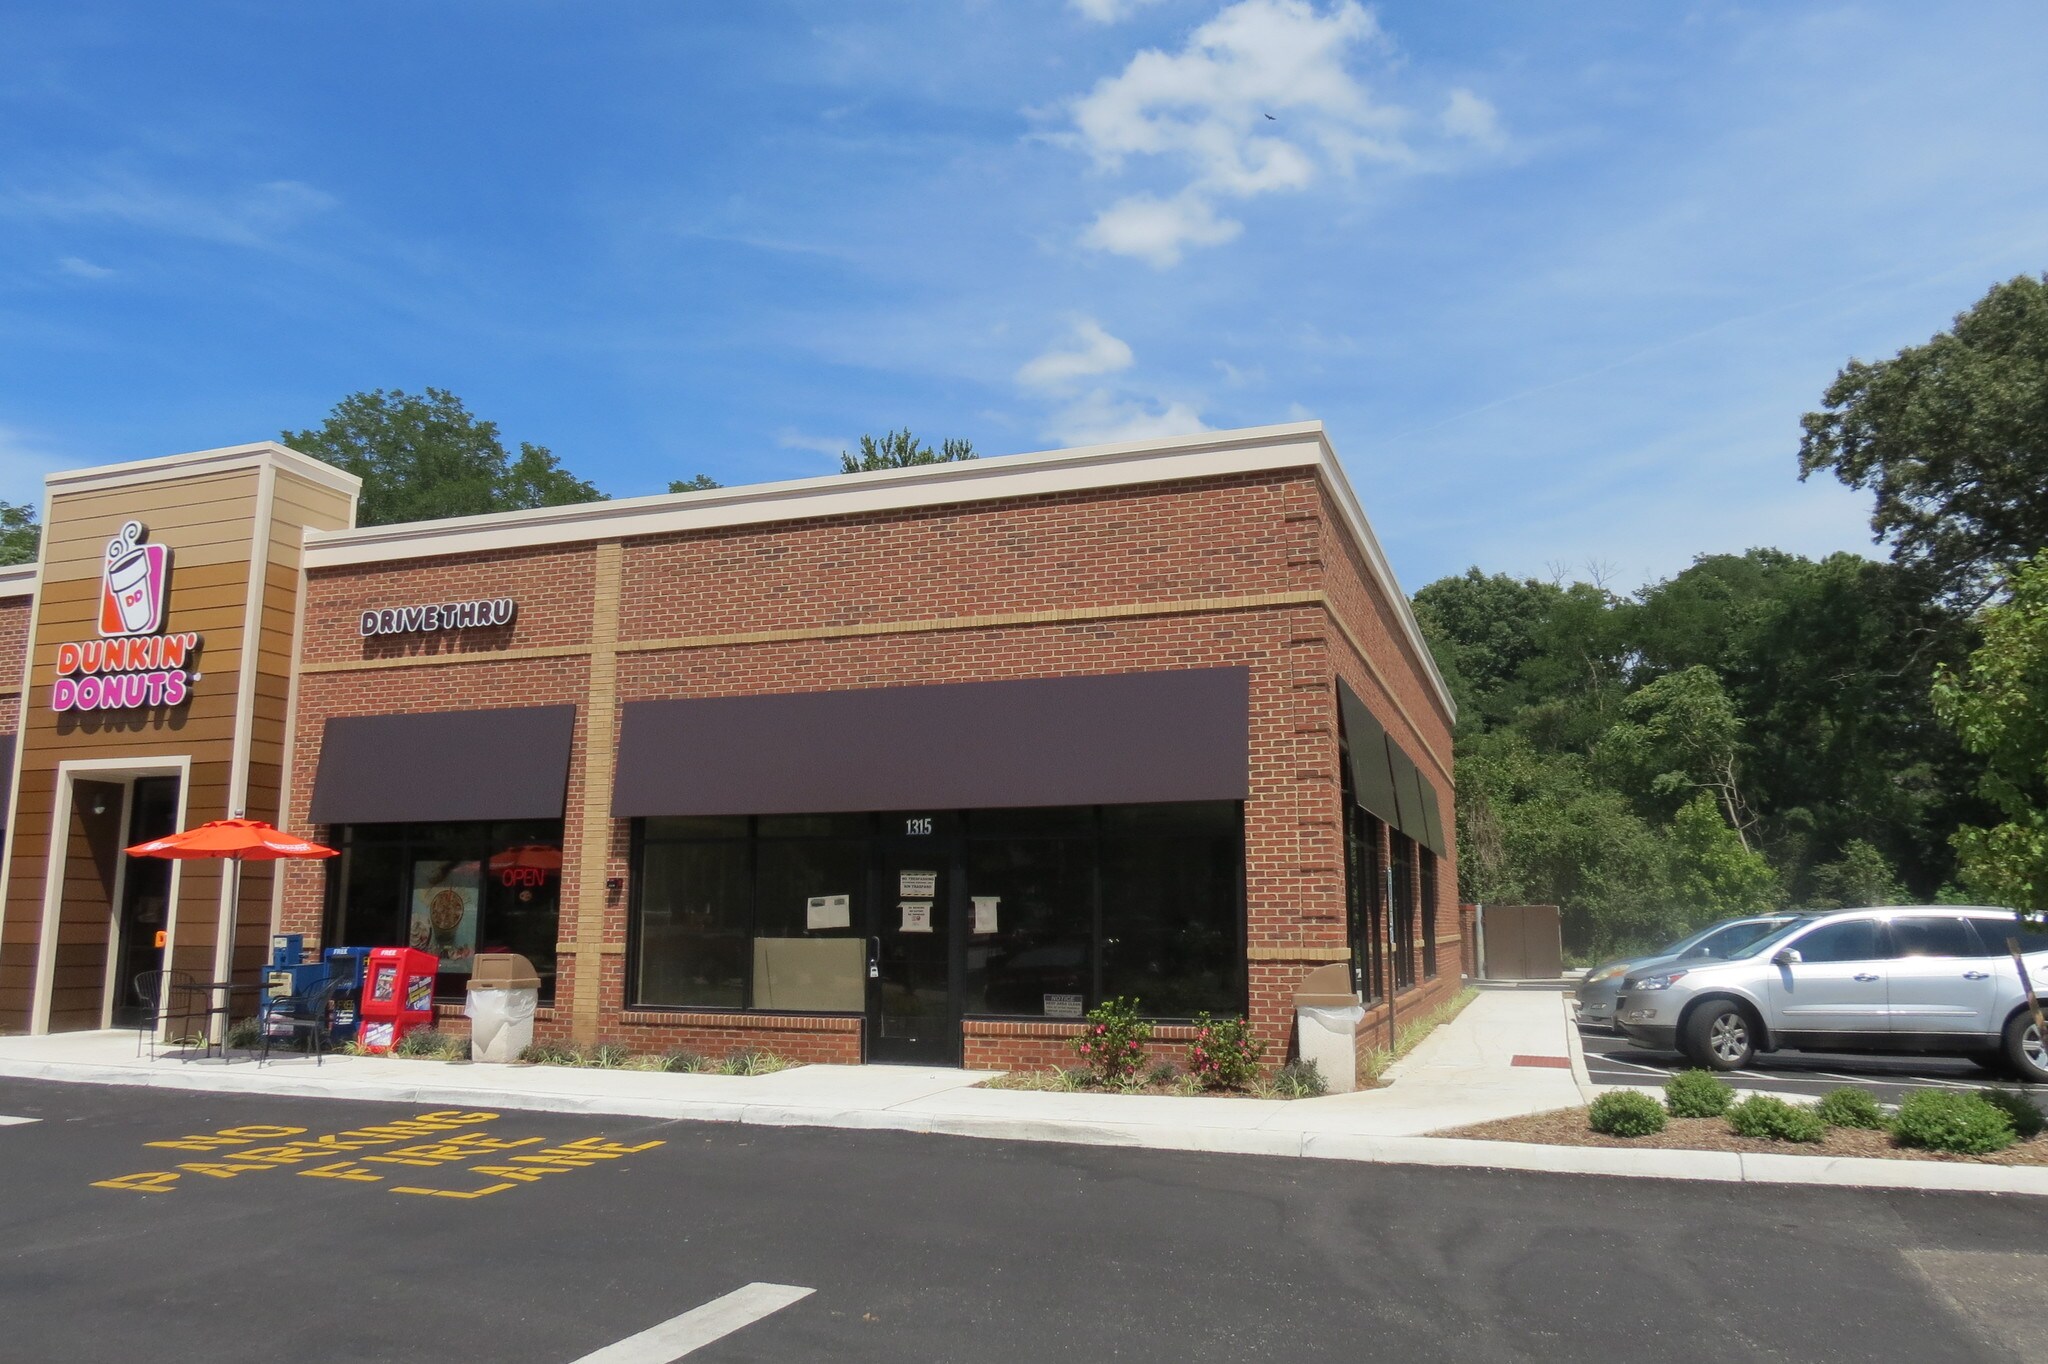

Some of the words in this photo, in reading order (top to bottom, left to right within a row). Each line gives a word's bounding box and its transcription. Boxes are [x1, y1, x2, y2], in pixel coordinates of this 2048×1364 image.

[125, 589, 143, 608] DD
[360, 605, 439, 636] DRIVE
[440, 598, 513, 629] THRU
[56, 632, 198, 675] DUNKIN'
[53, 669, 187, 711] DONUTS
[906, 818, 932, 835] 1315
[502, 868, 545, 887] OPEN
[89, 1110, 500, 1192] PARKING
[142, 1125, 308, 1150] NO
[296, 1132, 547, 1181] FIRE
[389, 1137, 667, 1199] LANE
